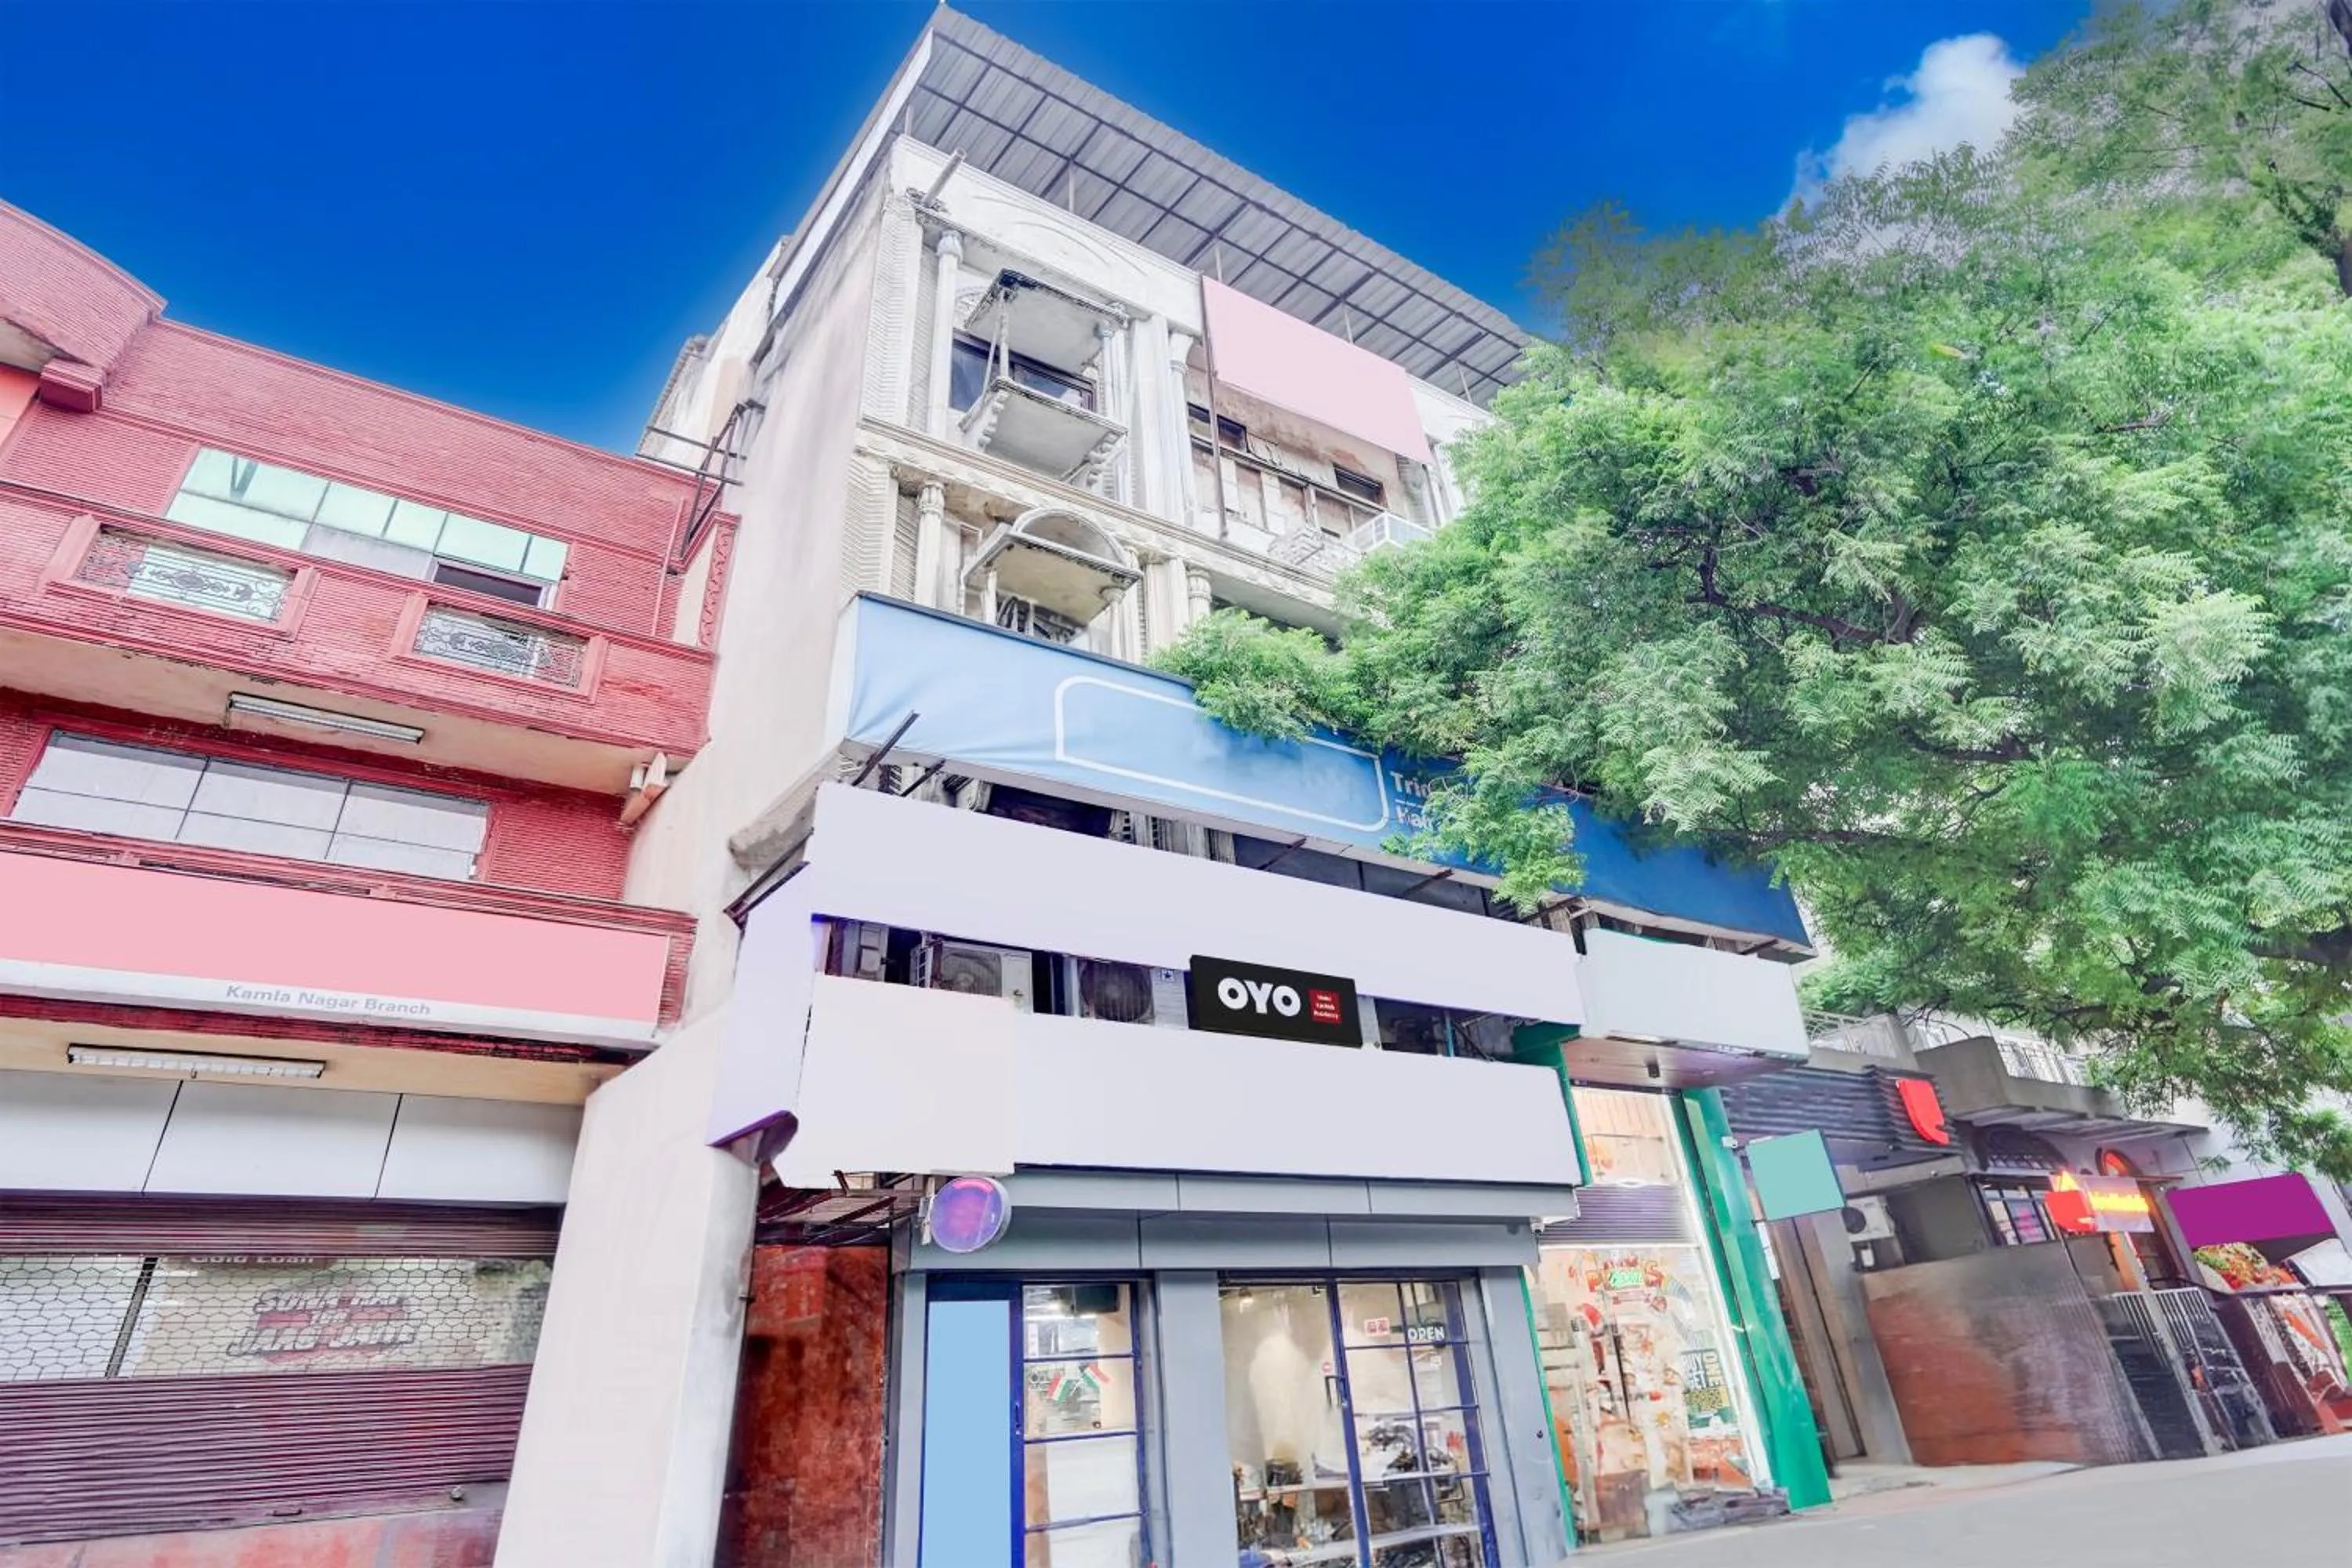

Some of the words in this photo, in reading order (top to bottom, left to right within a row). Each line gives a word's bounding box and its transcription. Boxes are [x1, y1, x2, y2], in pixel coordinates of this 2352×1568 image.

[226, 985, 291, 1003] Kamla
[298, 992, 358, 1009] Nagar
[364, 998, 431, 1015] Branch
[1218, 978, 1301, 1017] OYO
[1407, 1327, 1445, 1341] OPEN
